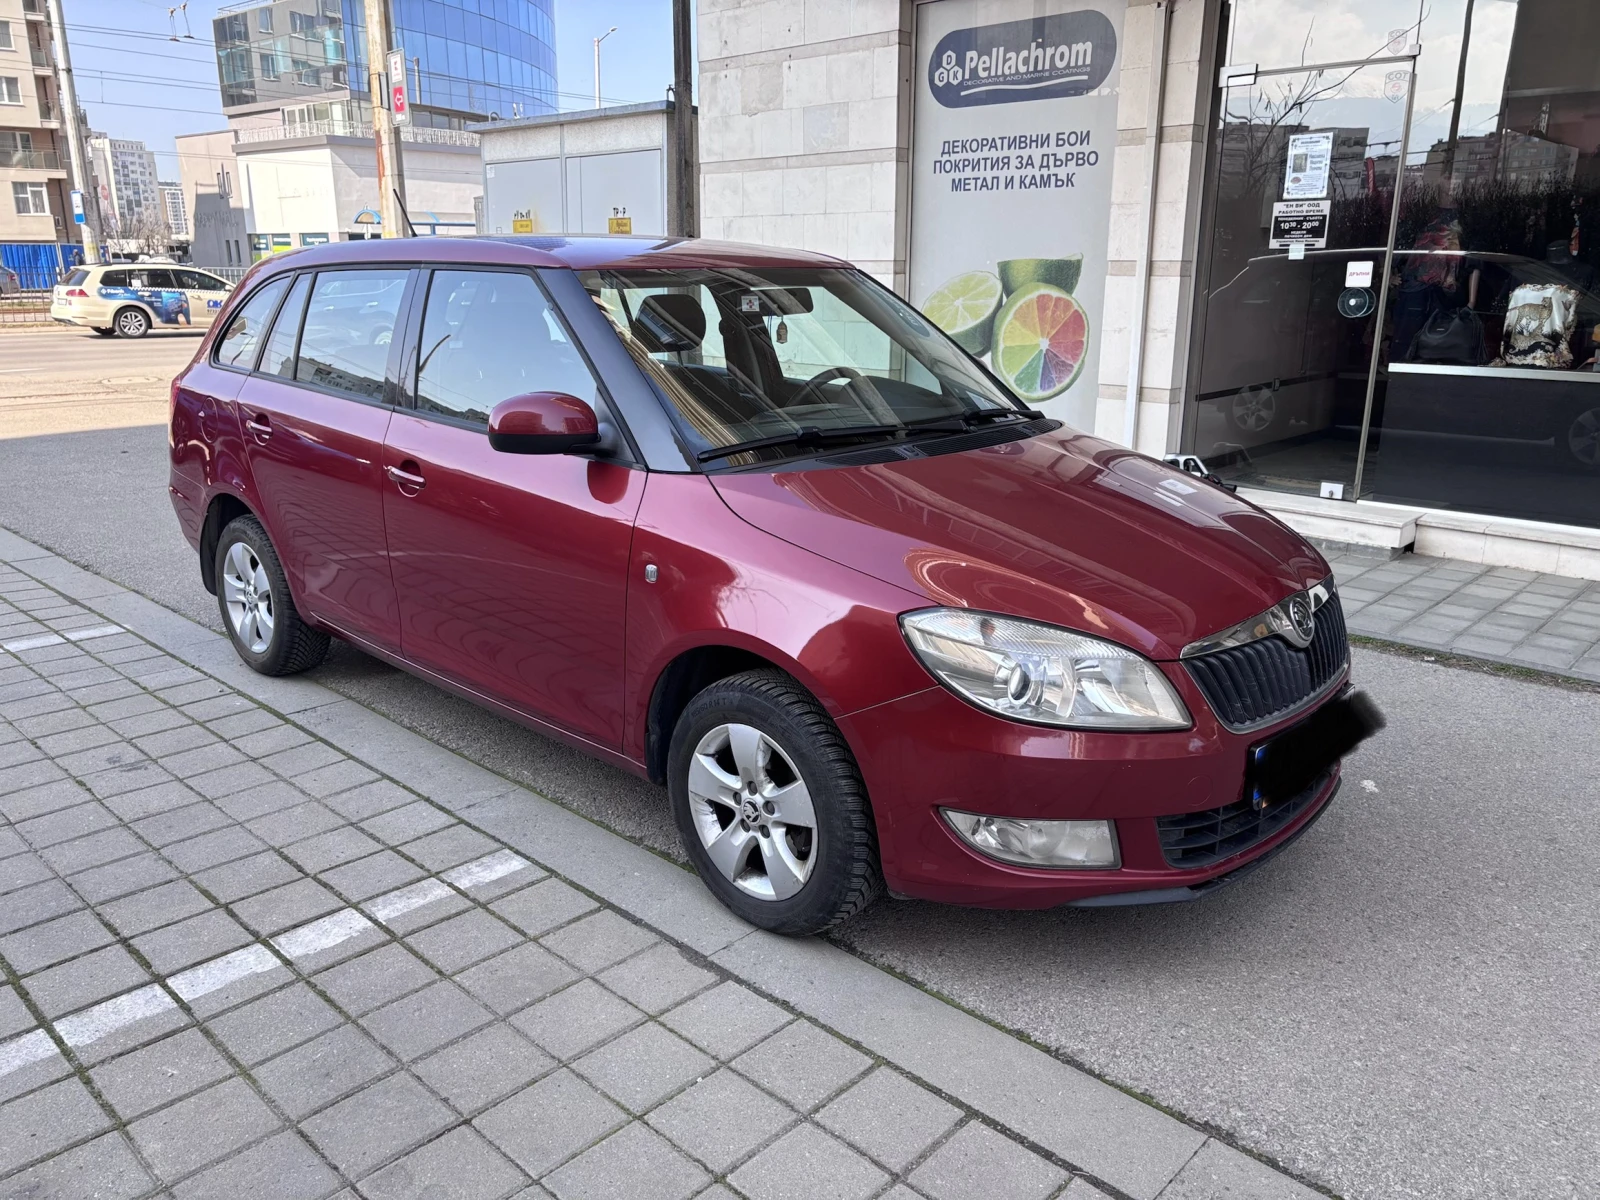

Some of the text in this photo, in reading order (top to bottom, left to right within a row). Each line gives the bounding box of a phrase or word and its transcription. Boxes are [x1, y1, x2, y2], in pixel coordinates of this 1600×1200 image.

[964, 41, 1093, 80] Pellachrom
[963, 66, 1091, 86] DECORATIVE AND MARINE COATINGS
[941, 130, 1090, 157] ДЕКОРАТИВНИ БОИ
[933, 150, 1099, 174] ПОКРИТИЯ ЗА ДЪРВО
[951, 172, 1076, 192] МЕТАЛ И КАМЪК
